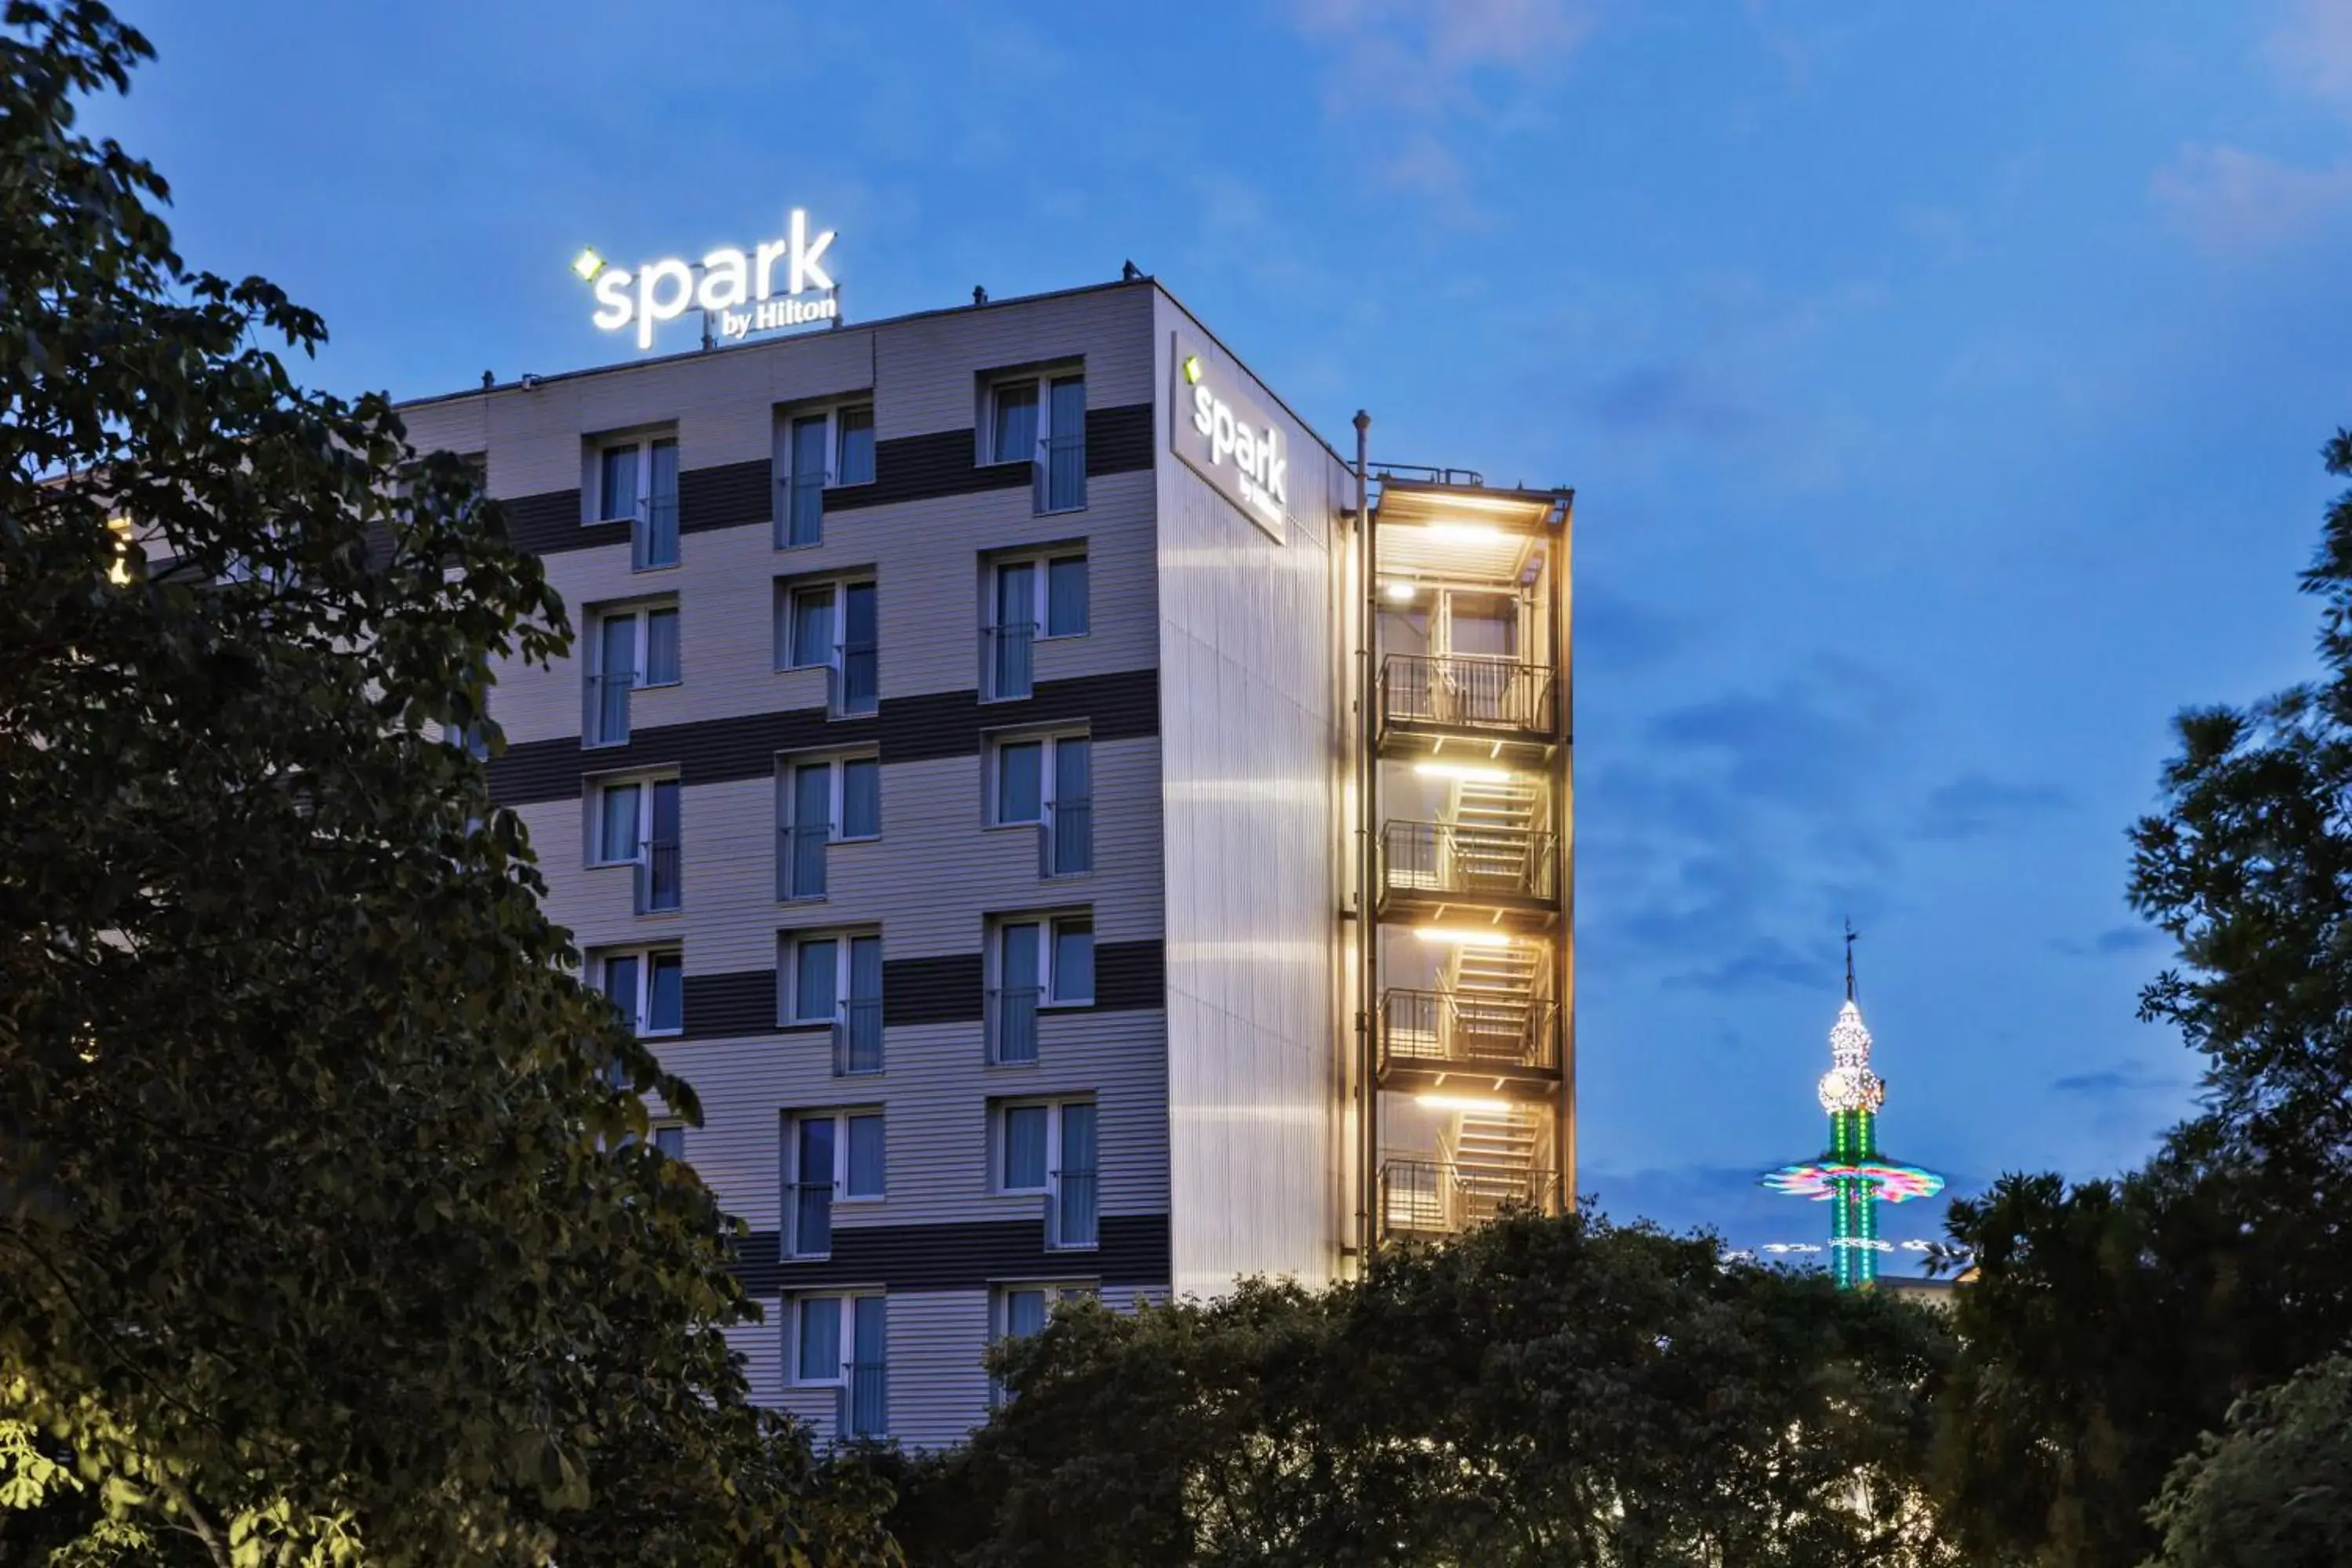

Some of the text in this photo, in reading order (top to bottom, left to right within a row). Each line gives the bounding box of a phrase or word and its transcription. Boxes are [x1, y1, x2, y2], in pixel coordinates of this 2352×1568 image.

[593, 209, 836, 350] spark
[722, 299, 837, 339] by Hilton
[1194, 385, 1287, 503] spark
